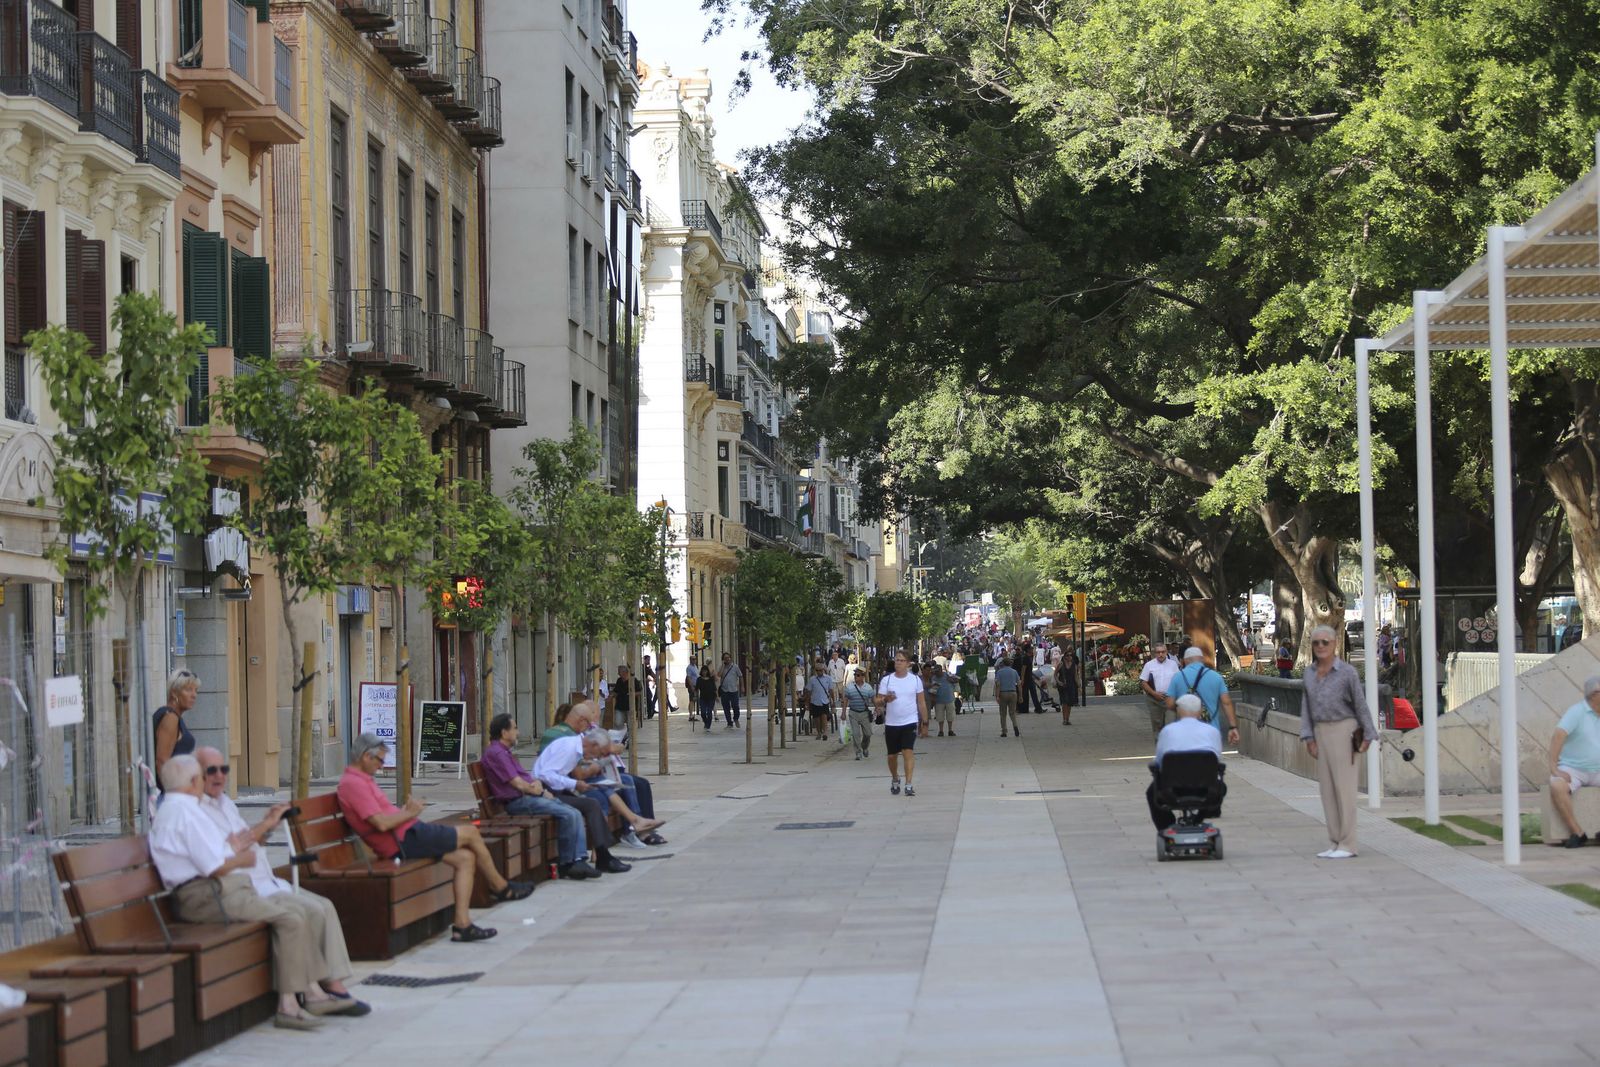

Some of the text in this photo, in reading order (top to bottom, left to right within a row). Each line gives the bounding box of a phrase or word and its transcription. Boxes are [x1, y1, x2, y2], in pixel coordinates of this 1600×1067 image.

[1460, 620, 1470, 628] 14
[1475, 619, 1486, 628] 32
[1466, 631, 1494, 640] 34 35
